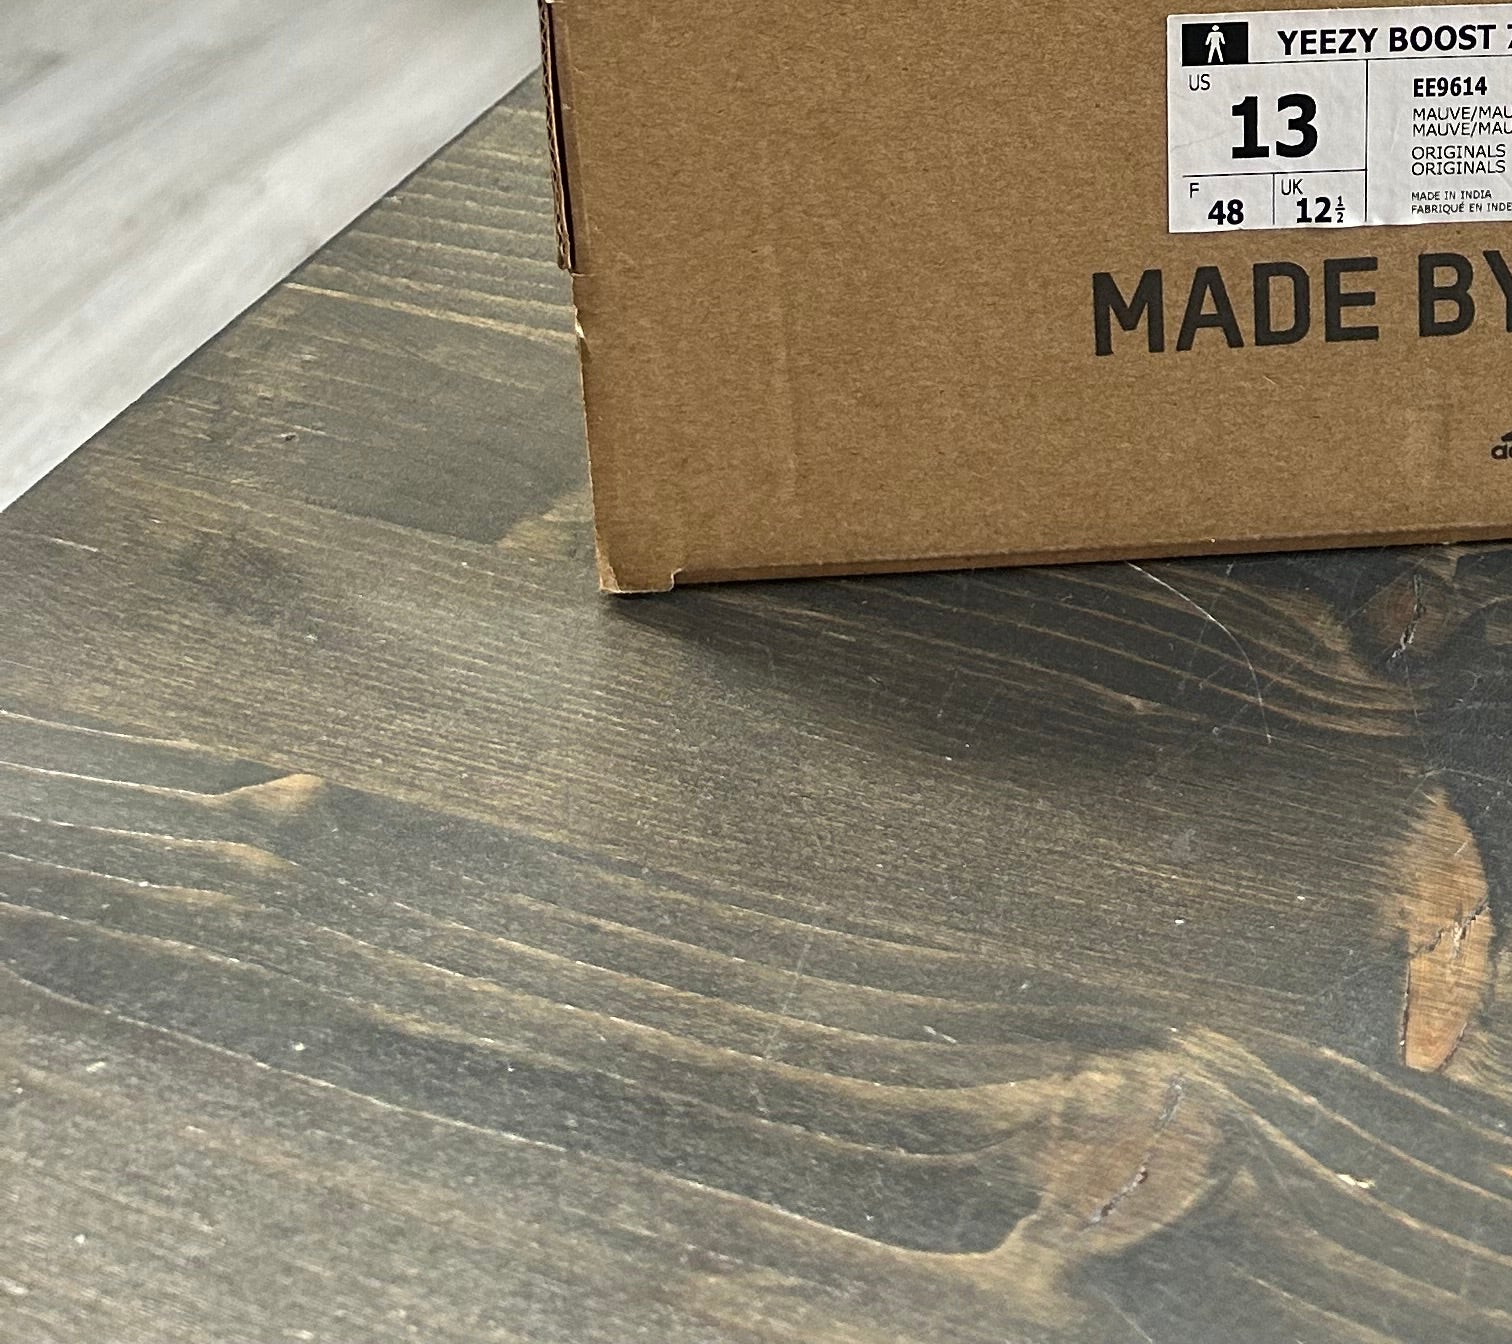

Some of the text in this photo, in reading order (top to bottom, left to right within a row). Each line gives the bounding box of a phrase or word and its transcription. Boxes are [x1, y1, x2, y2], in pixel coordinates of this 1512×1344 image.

[1277, 27, 1379, 56] YEEZY
[1389, 24, 1497, 53] BOOST
[1188, 73, 1211, 92] US
[1413, 76, 1488, 98] EE9614
[1231, 93, 1319, 159] 13
[1411, 143, 1506, 160] ORIGINALS
[1411, 159, 1506, 176] ORIGINALS
[1189, 182, 1200, 199] F
[1281, 178, 1304, 196] UK
[1411, 189, 1493, 202] MADE IN INDIA
[1207, 198, 1245, 226] 48
[1411, 201, 1512, 215] FABRIQUÉ EN INDE
[1091, 254, 1380, 357] MADE
